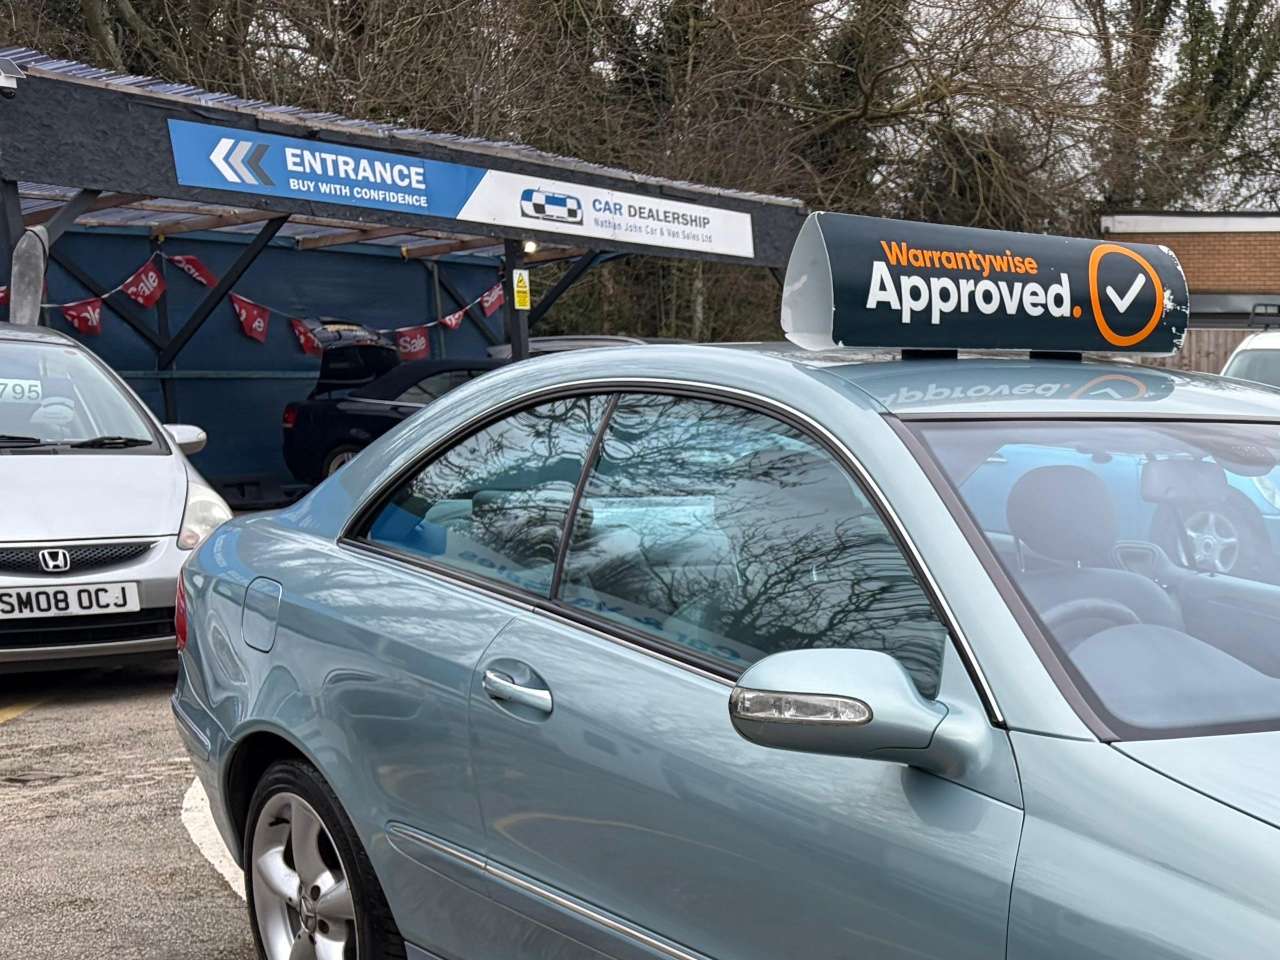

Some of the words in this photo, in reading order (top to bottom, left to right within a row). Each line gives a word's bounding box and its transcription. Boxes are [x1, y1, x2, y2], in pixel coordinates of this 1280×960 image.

[285, 147, 426, 190] ENTRANCE
[289, 178, 315, 194] BUY
[318, 182, 350, 197] WITH
[353, 187, 428, 207] CONFIDENCE
[592, 199, 623, 216] CAR
[628, 205, 711, 229] DEALERSHIP
[645, 225, 658, 236] Car
[880, 240, 1039, 277] Warrantywise
[866, 261, 1082, 325] Approved.
[399, 333, 426, 354] Sale
[0, 591, 70, 614] SM08
[77, 586, 128, 610] OCJ
